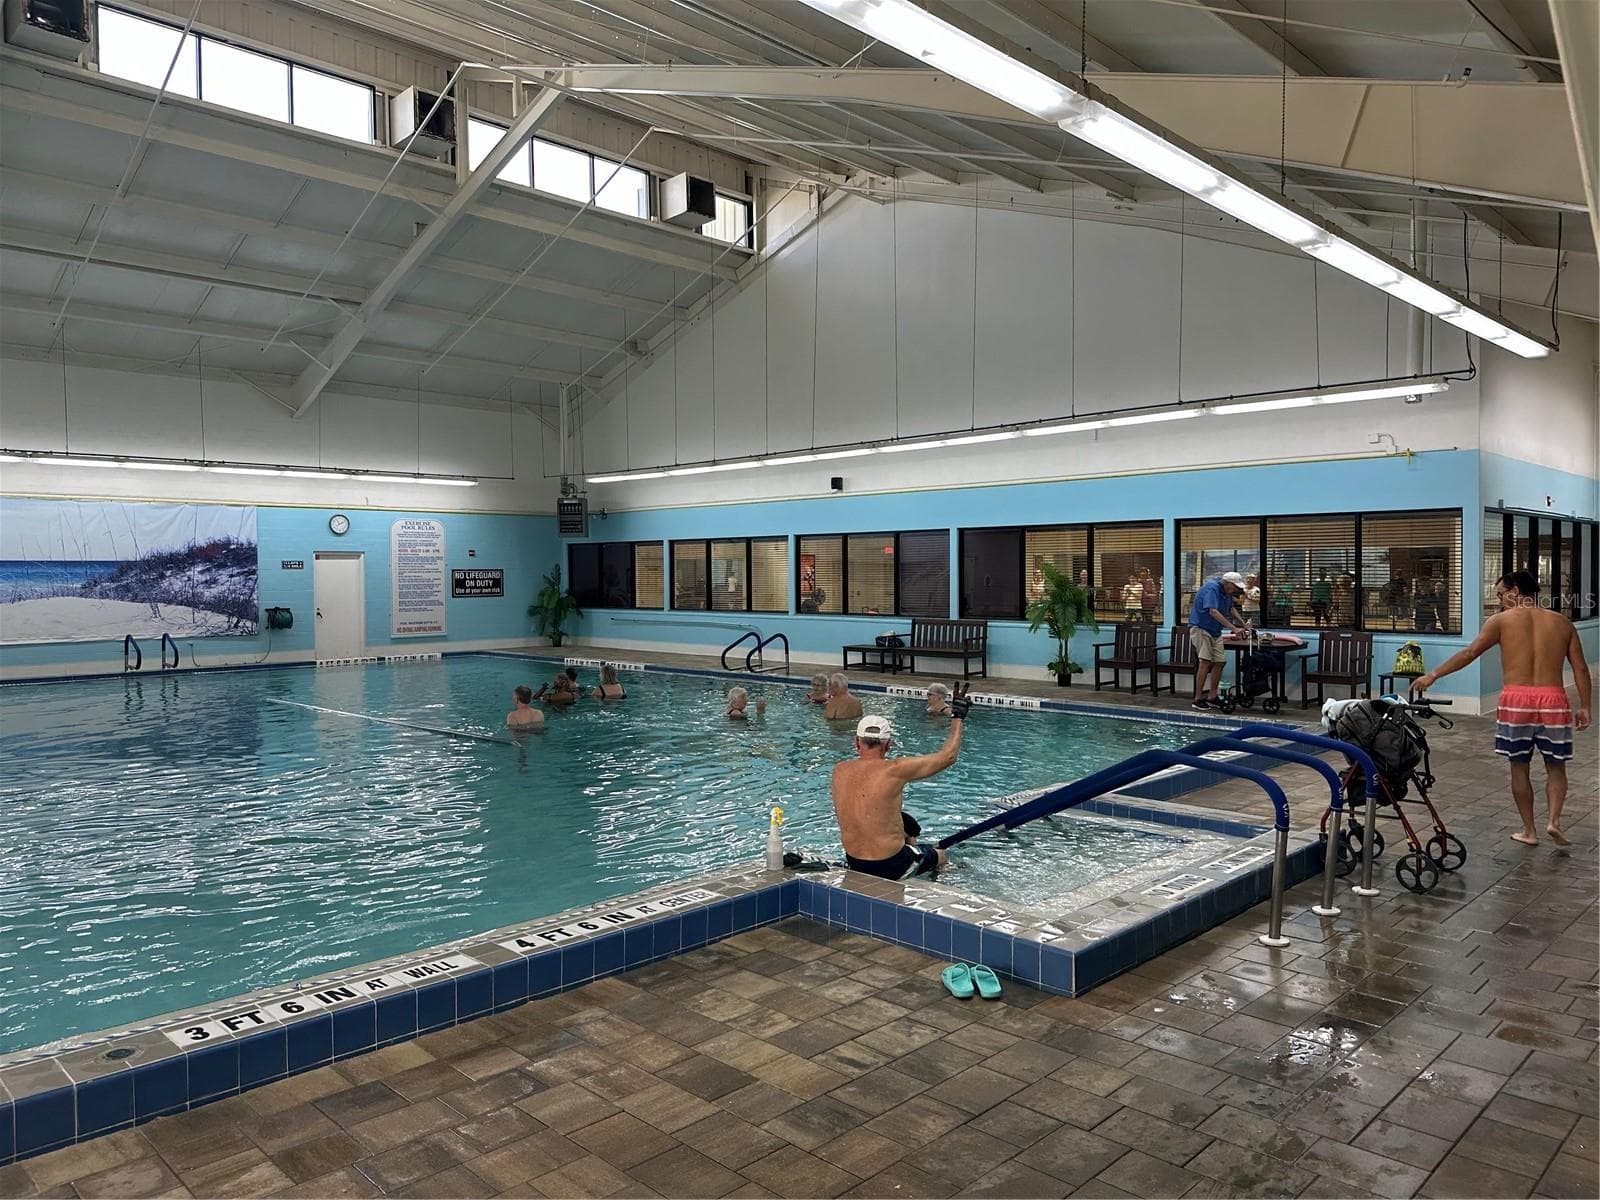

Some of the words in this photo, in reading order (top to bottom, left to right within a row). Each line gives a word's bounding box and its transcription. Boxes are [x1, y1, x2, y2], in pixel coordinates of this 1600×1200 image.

[515, 939, 536, 949] 4
[537, 928, 573, 942] FT
[577, 921, 599, 930] 6
[600, 911, 634, 924] IN
[636, 905, 657, 914] AT
[659, 891, 713, 908] CENTER
[184, 1027, 210, 1041] 3
[220, 1010, 265, 1031] FT
[280, 1001, 305, 1014] 6
[314, 987, 357, 1004] IN
[364, 978, 389, 991] AT
[403, 960, 459, 979] WALL
